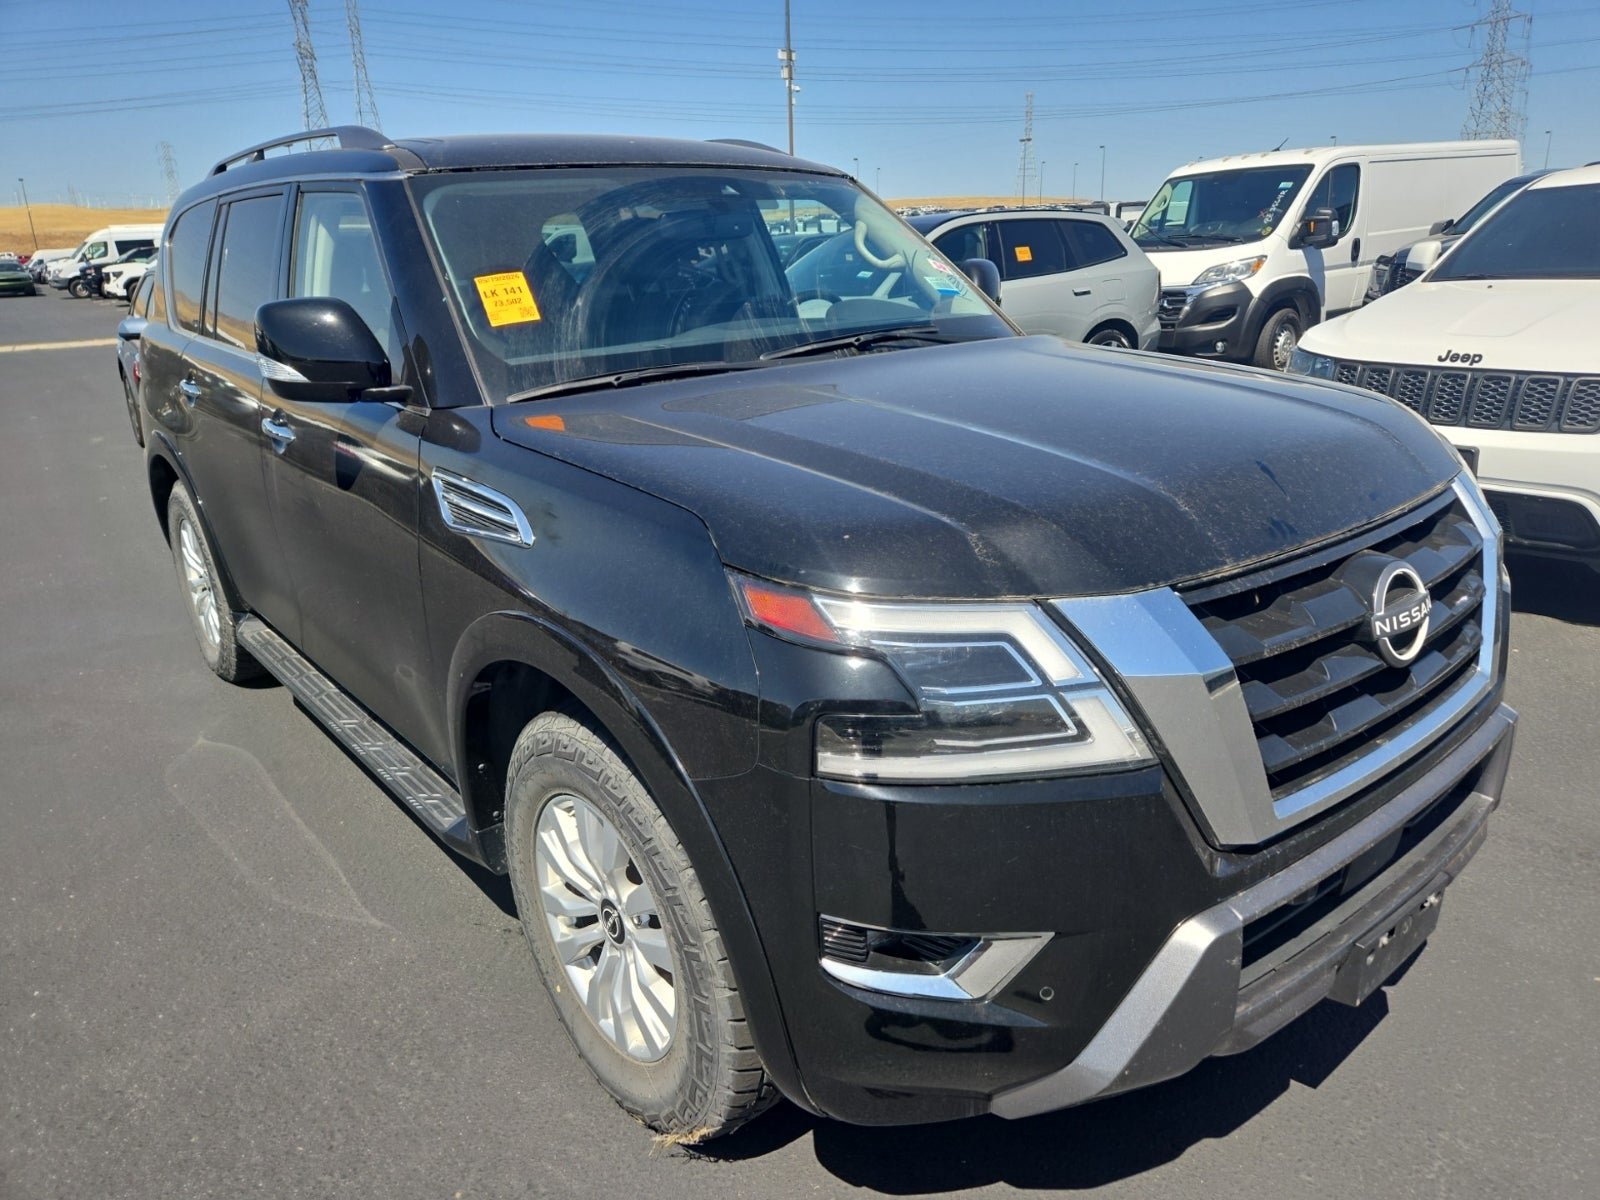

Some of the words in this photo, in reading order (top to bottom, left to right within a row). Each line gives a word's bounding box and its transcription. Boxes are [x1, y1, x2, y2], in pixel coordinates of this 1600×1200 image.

[483, 289, 499, 299] LK
[503, 286, 523, 295] 141
[1437, 349, 1483, 366] Jeep
[1374, 593, 1432, 635] NISSAN
